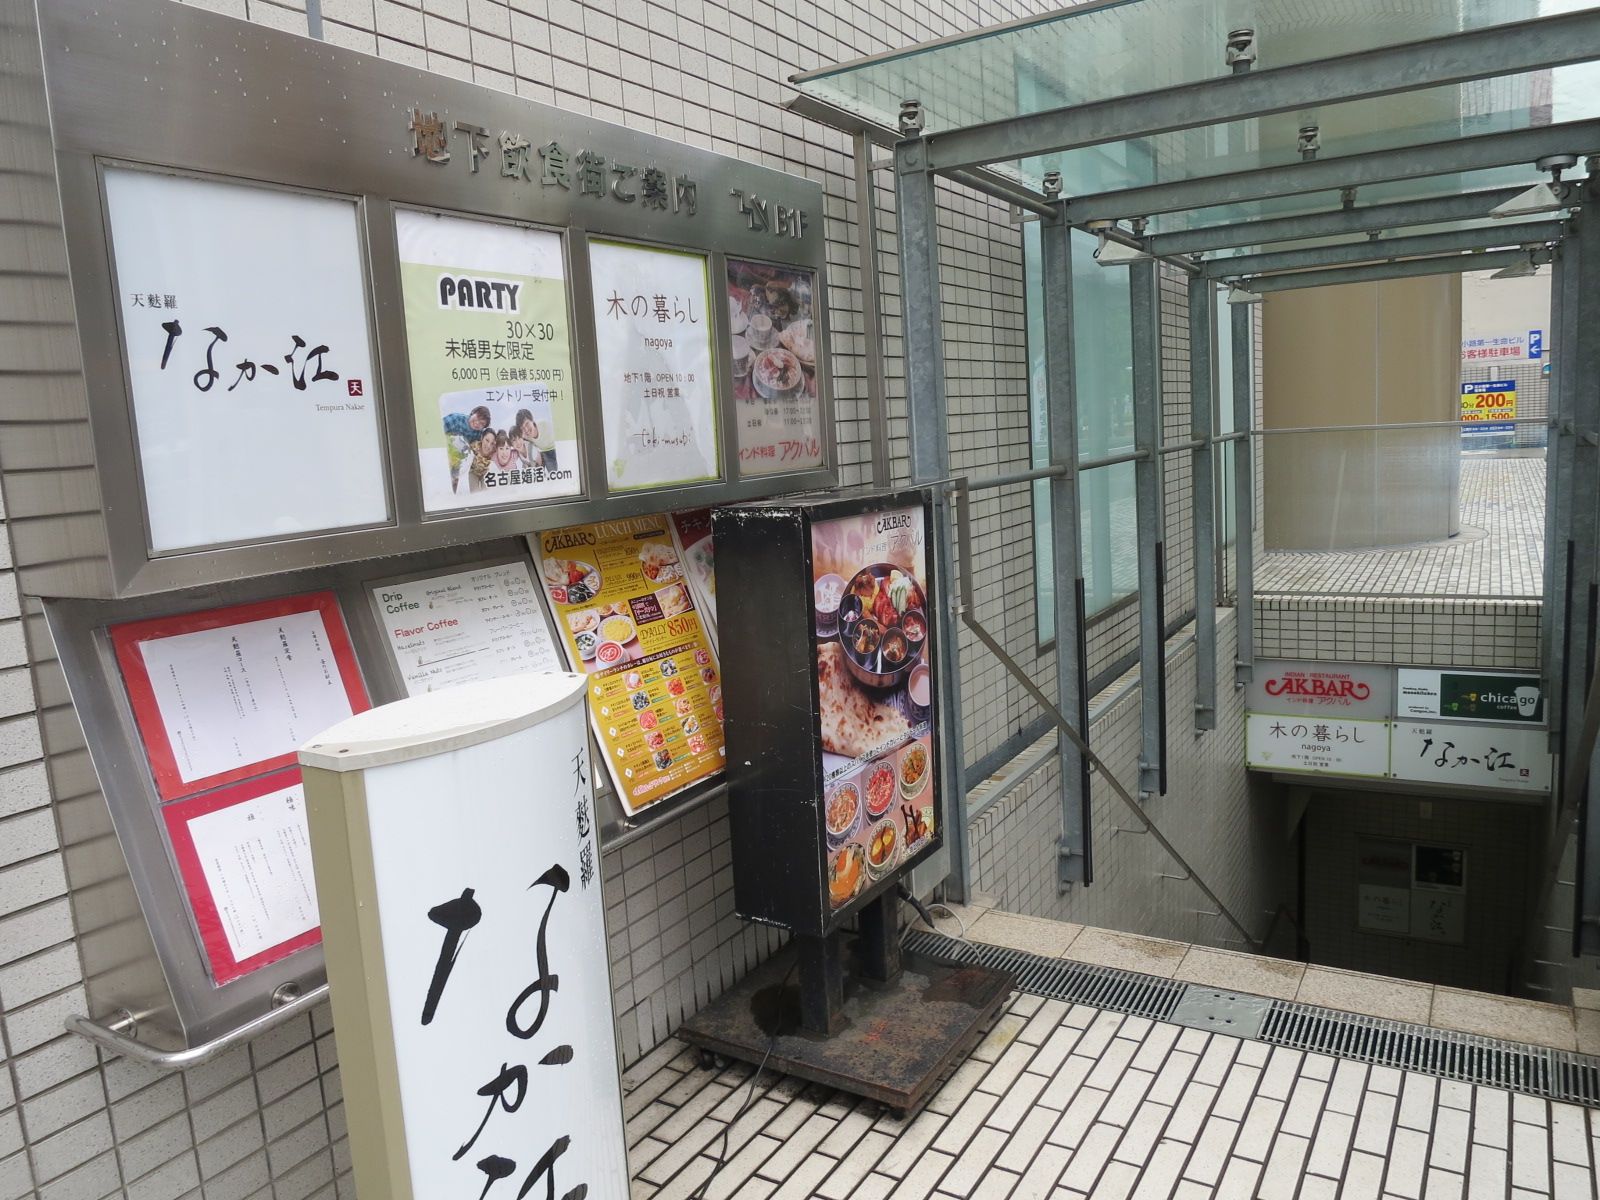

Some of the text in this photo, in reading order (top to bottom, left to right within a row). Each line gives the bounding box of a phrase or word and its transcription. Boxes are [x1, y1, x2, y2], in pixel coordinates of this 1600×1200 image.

[408, 107, 808, 239] 地下飲食街ご案内 B1F
[440, 277, 520, 310] PARTY
[606, 290, 699, 324] 木の暮らし
[644, 337, 673, 348] nagoya
[1530, 333, 1540, 345] P
[160, 319, 340, 392] なか江
[445, 339, 535, 360] 未婚男女限定
[347, 379, 363, 396] 天
[656, 373, 674, 383] OPEN
[1464, 384, 1474, 394] P
[315, 403, 366, 413] Tempura Nakae
[1475, 393, 1506, 409] 200
[778, 438, 820, 461] アクバル
[484, 467, 573, 487] 名古屋婚活.com
[594, 521, 632, 539] LUNCH
[877, 514, 912, 534] AKBAR
[545, 532, 597, 554] AKBAR
[382, 591, 403, 603] Drip
[386, 602, 420, 614] Coffee
[394, 618, 459, 639] Flavor Coffee
[667, 616, 698, 637] 850円
[1310, 672, 1351, 680] RESTAURANT
[1265, 677, 1370, 701] AKBAR
[1480, 691, 1536, 706] chicago
[1317, 696, 1351, 706] アクバル
[1269, 721, 1365, 743] 木の暮らし
[1301, 744, 1331, 752] nagoya
[1420, 738, 1516, 771] なか江
